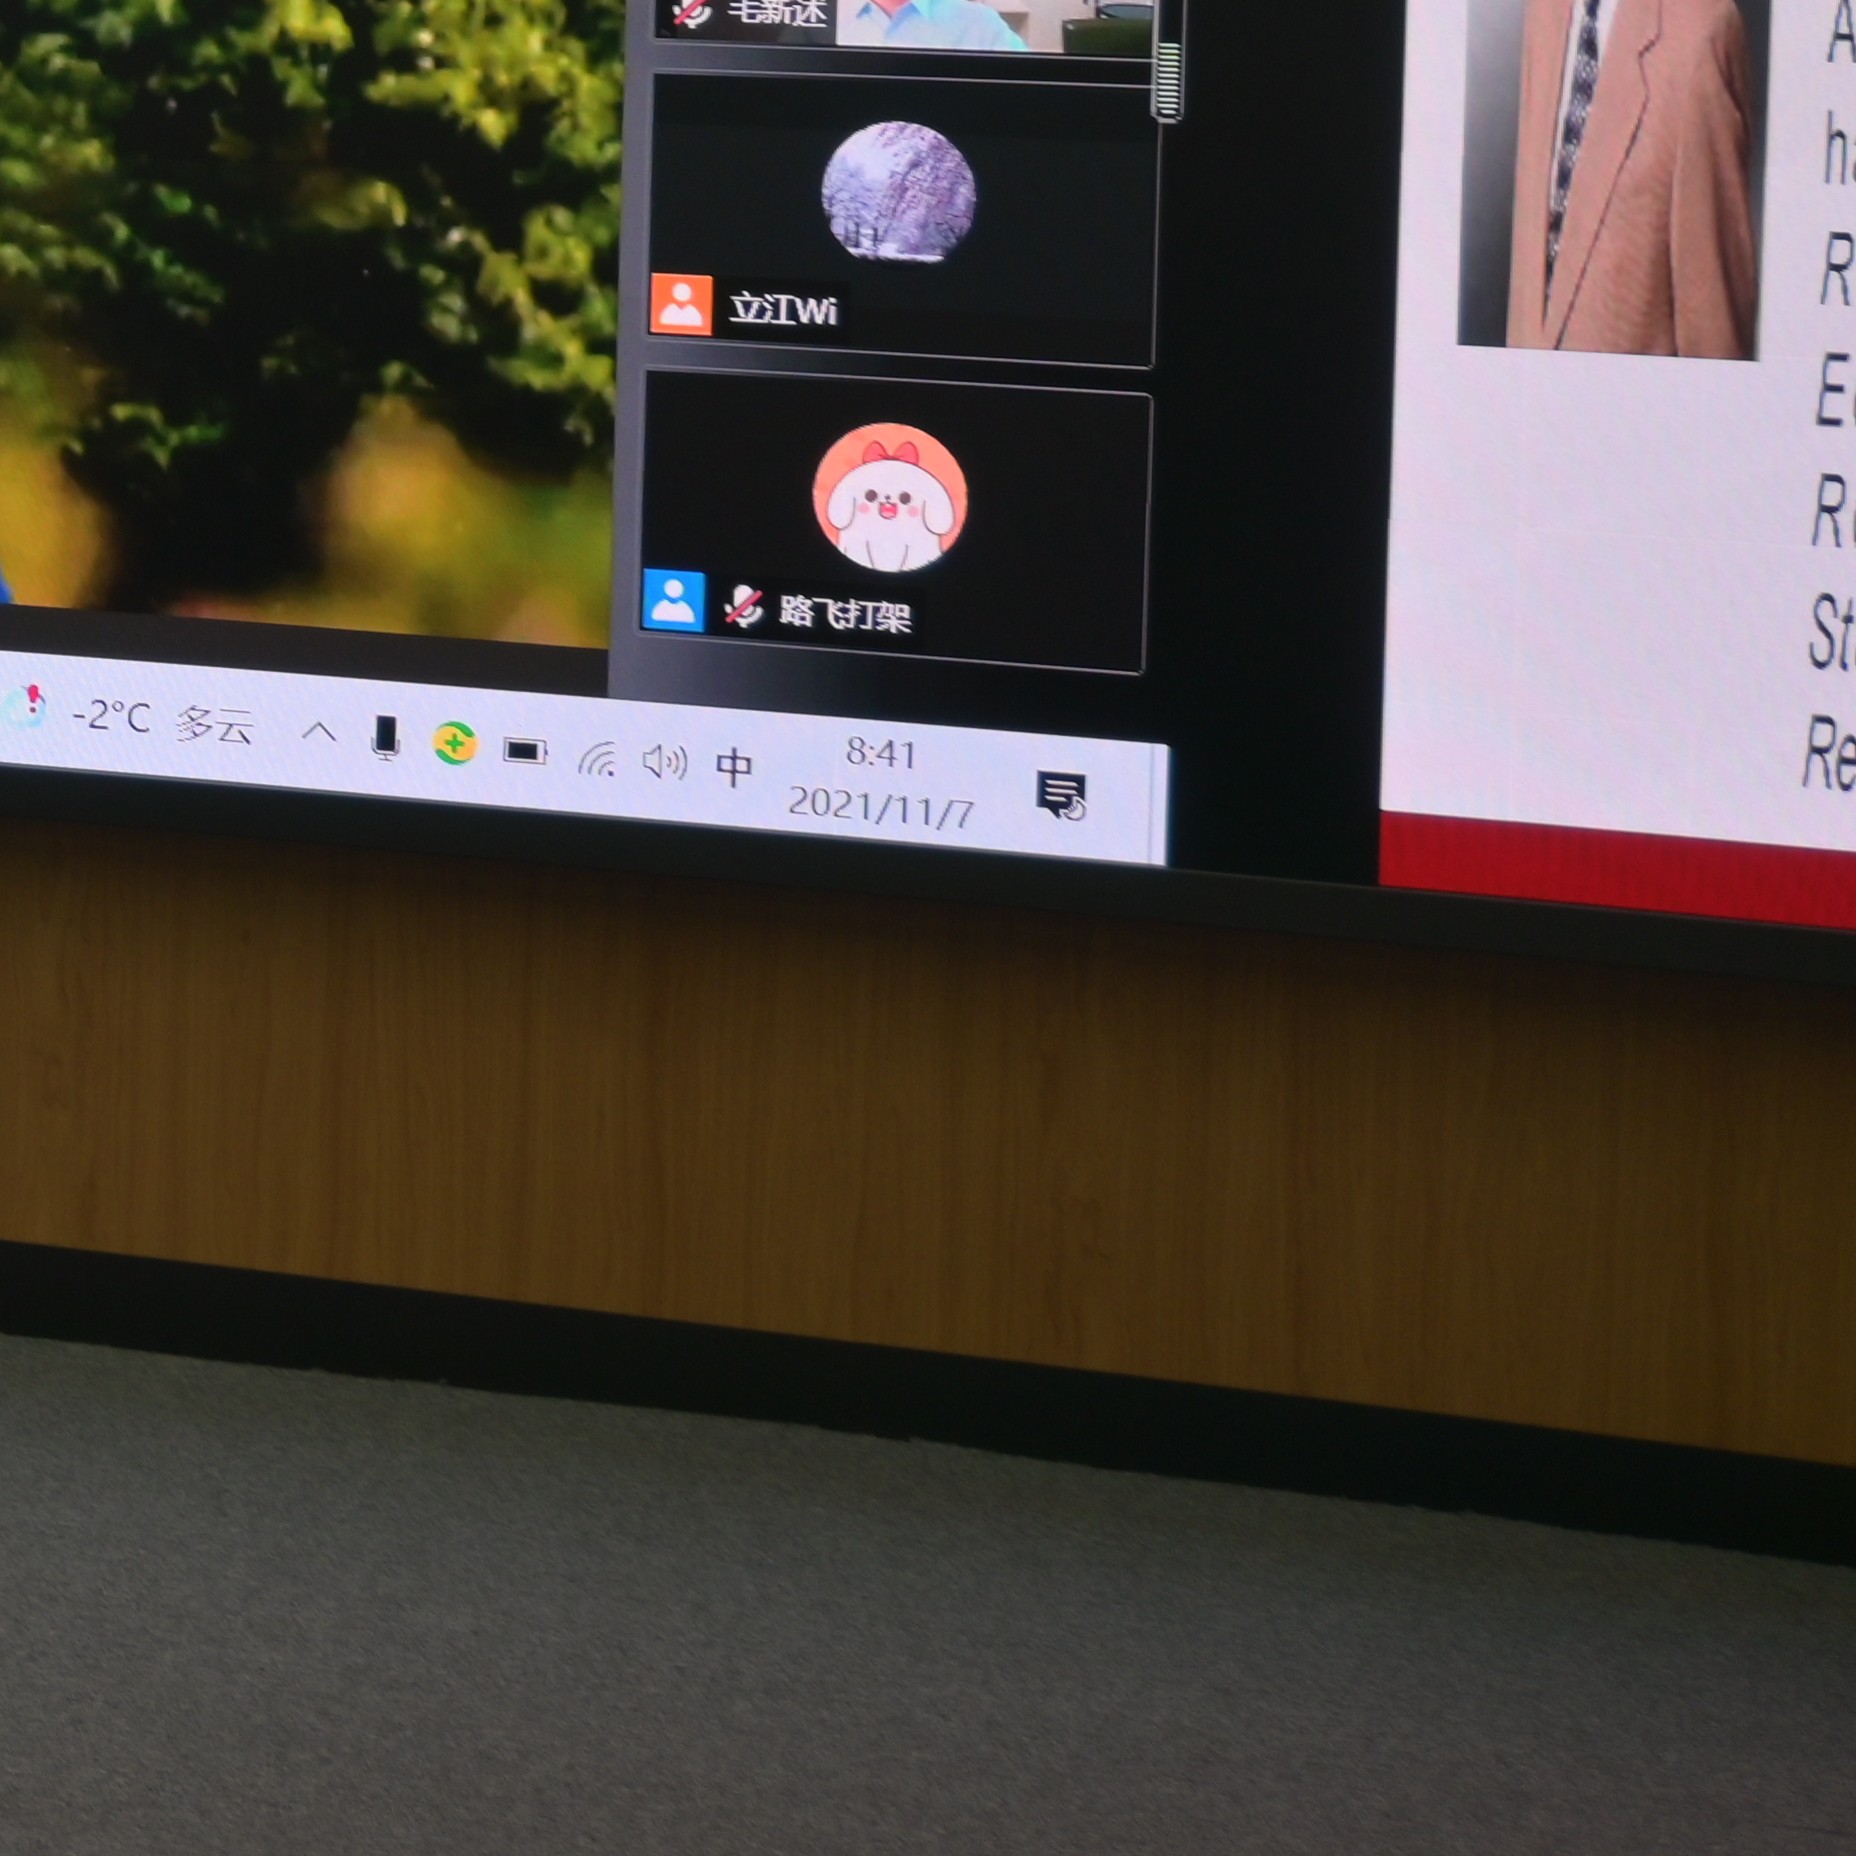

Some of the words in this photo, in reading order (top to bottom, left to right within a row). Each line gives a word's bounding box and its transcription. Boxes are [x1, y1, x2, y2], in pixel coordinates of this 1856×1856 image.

[780, 595, 912, 634] 路飞打架
[176, 705, 254, 745] 多云
[716, 747, 752, 788] 中
[846, 736, 916, 771] 8:41
[788, 785, 975, 831] 2021/11/7
